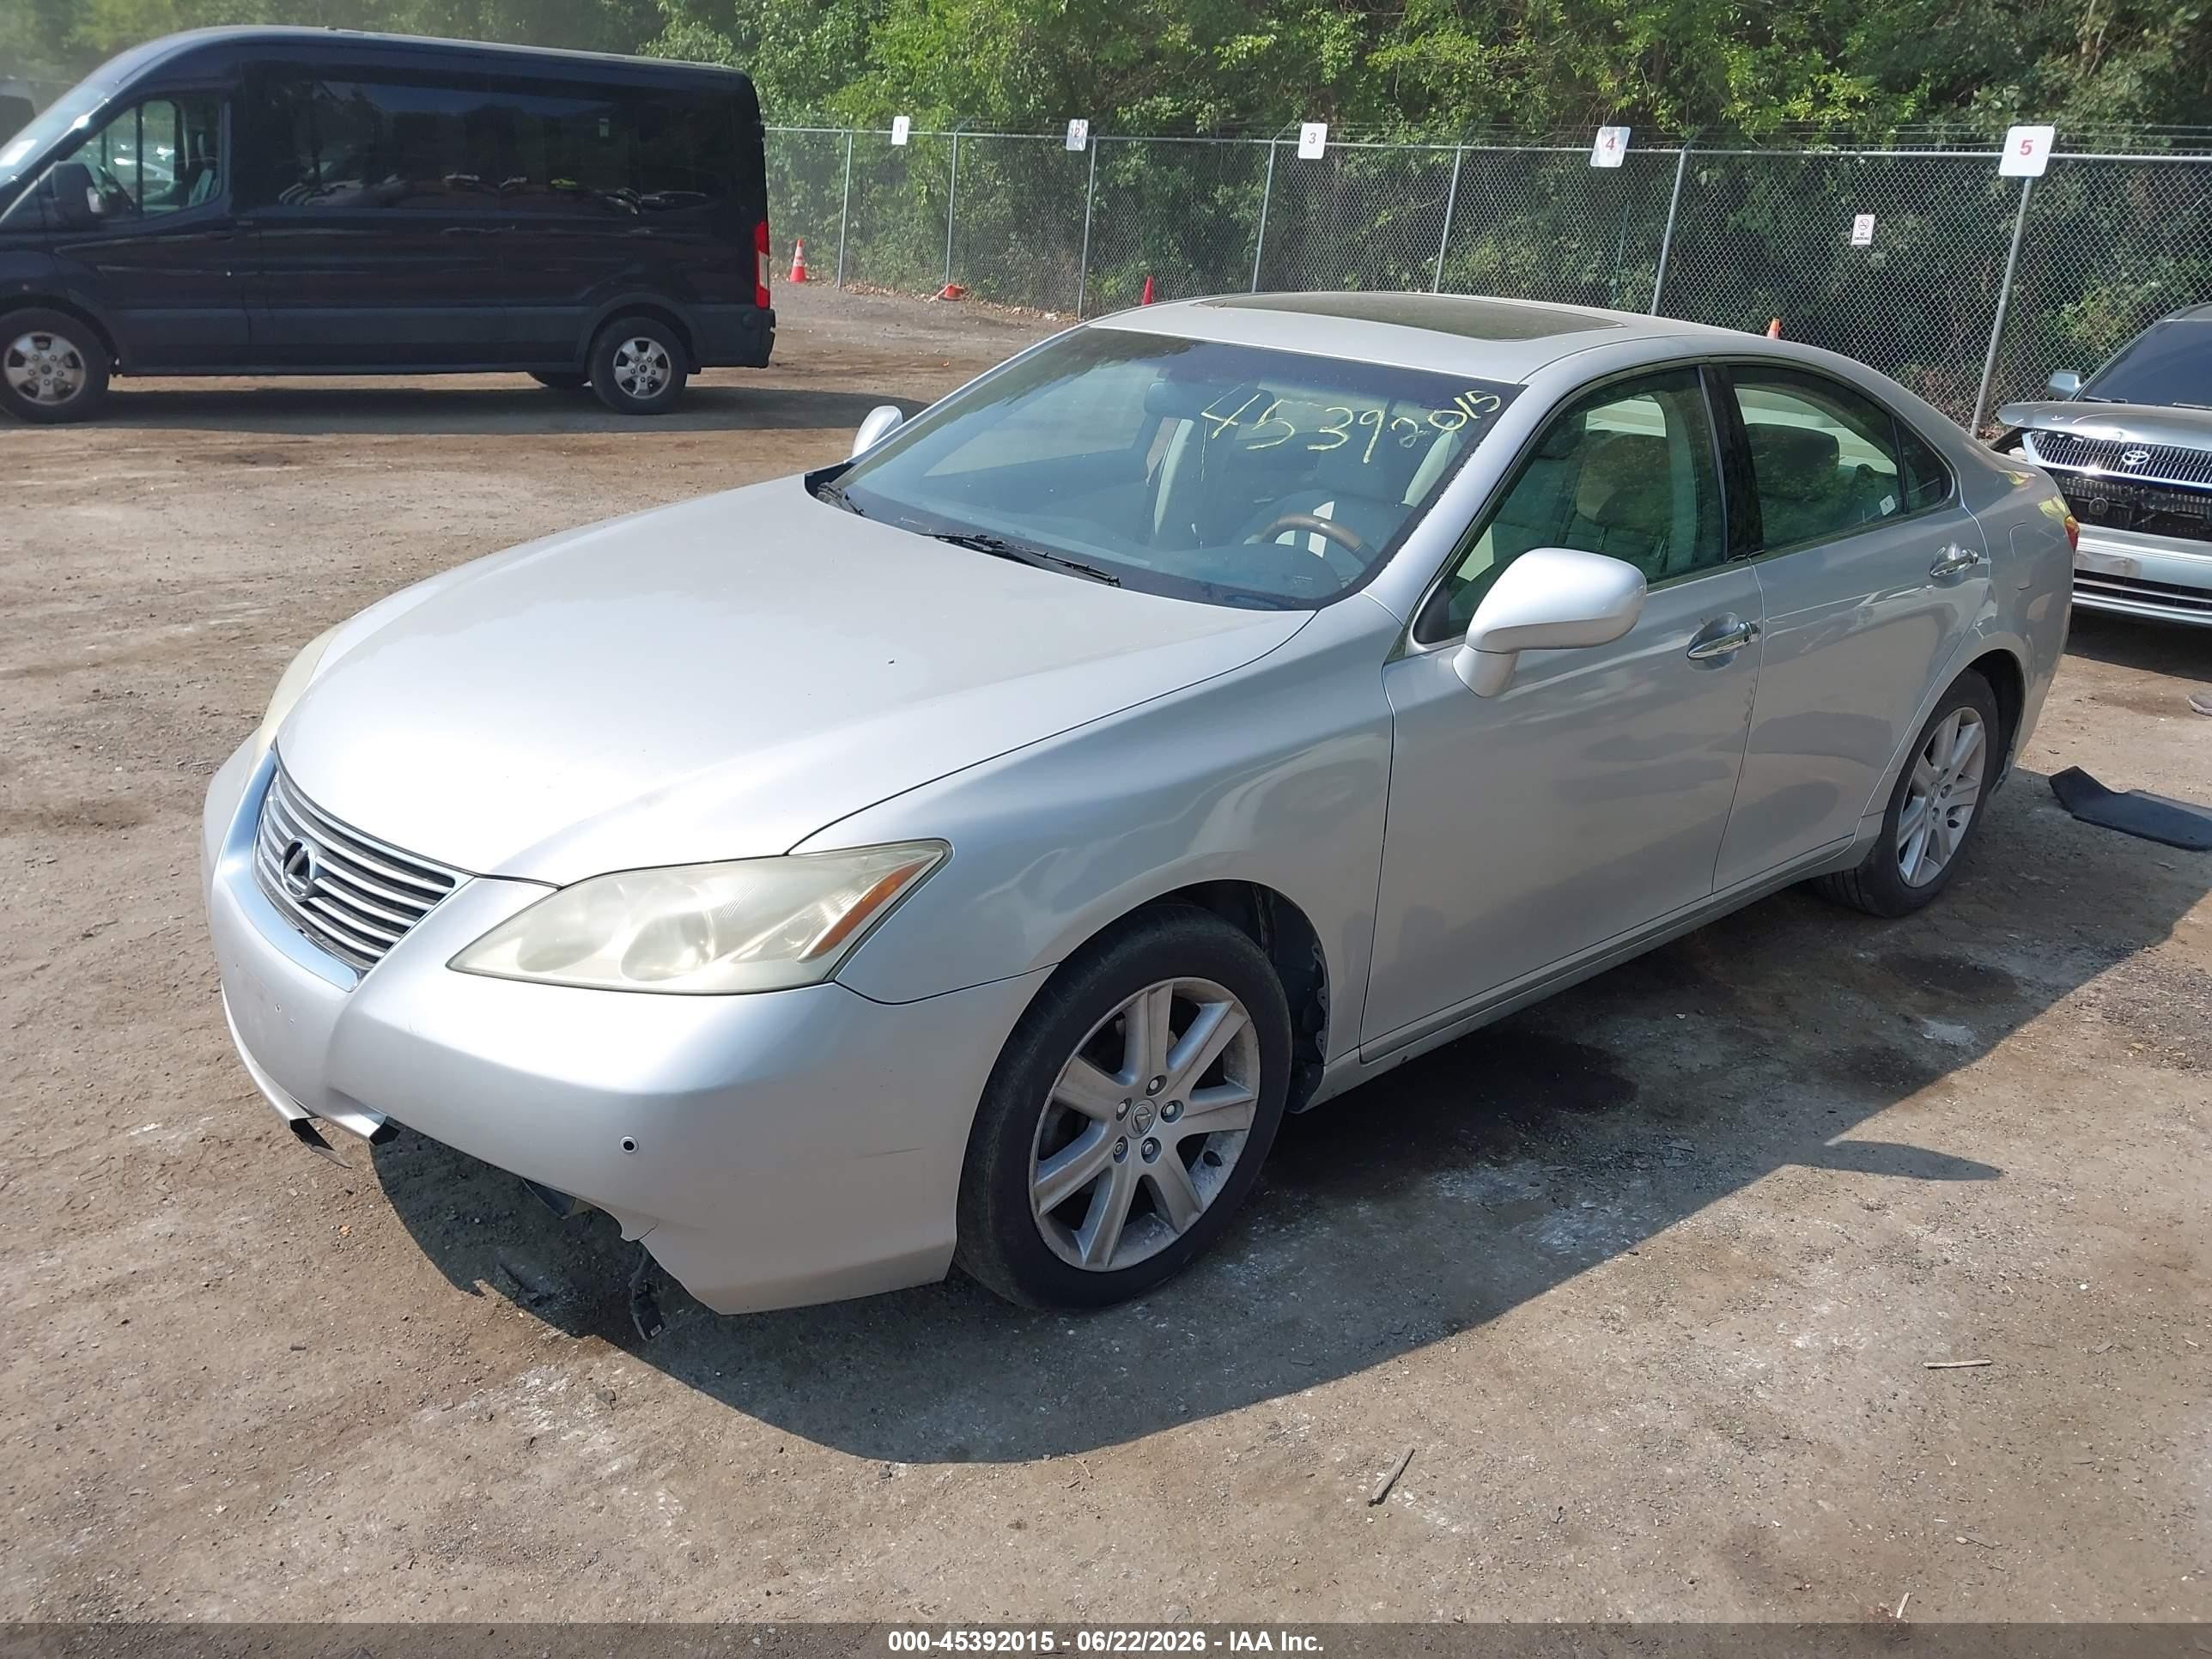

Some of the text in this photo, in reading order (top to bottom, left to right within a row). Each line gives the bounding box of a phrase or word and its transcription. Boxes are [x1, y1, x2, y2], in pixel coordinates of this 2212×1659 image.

[1309, 132, 1316, 143] 3
[1605, 137, 1615, 150] 4
[2020, 140, 2033, 155] 5
